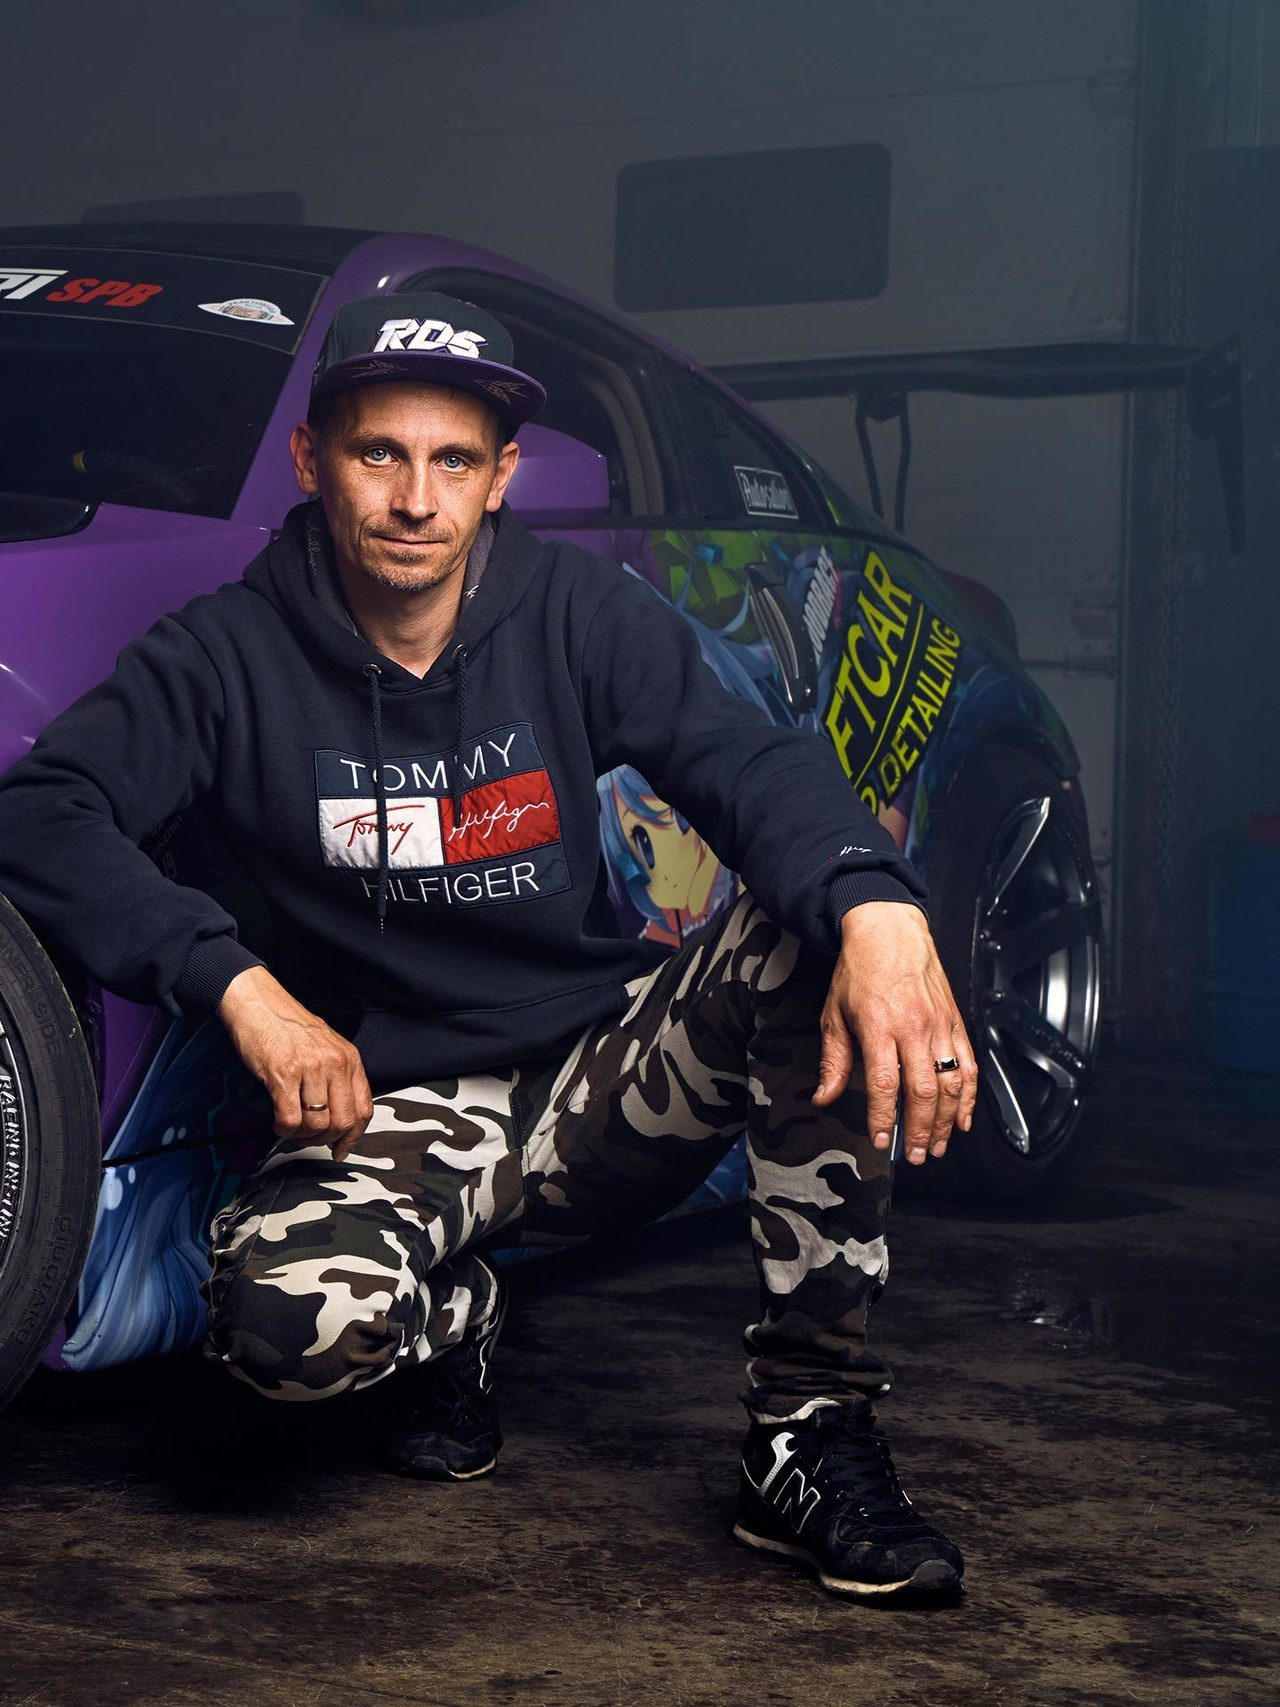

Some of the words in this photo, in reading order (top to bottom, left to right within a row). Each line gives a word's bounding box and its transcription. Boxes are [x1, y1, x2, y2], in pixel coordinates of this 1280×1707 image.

[46, 277, 164, 308] SPB
[371, 318, 489, 360] RDS
[877, 618, 962, 799] DETAILING
[339, 732, 517, 792] TOMMY
[360, 860, 541, 905] HILFIGER
